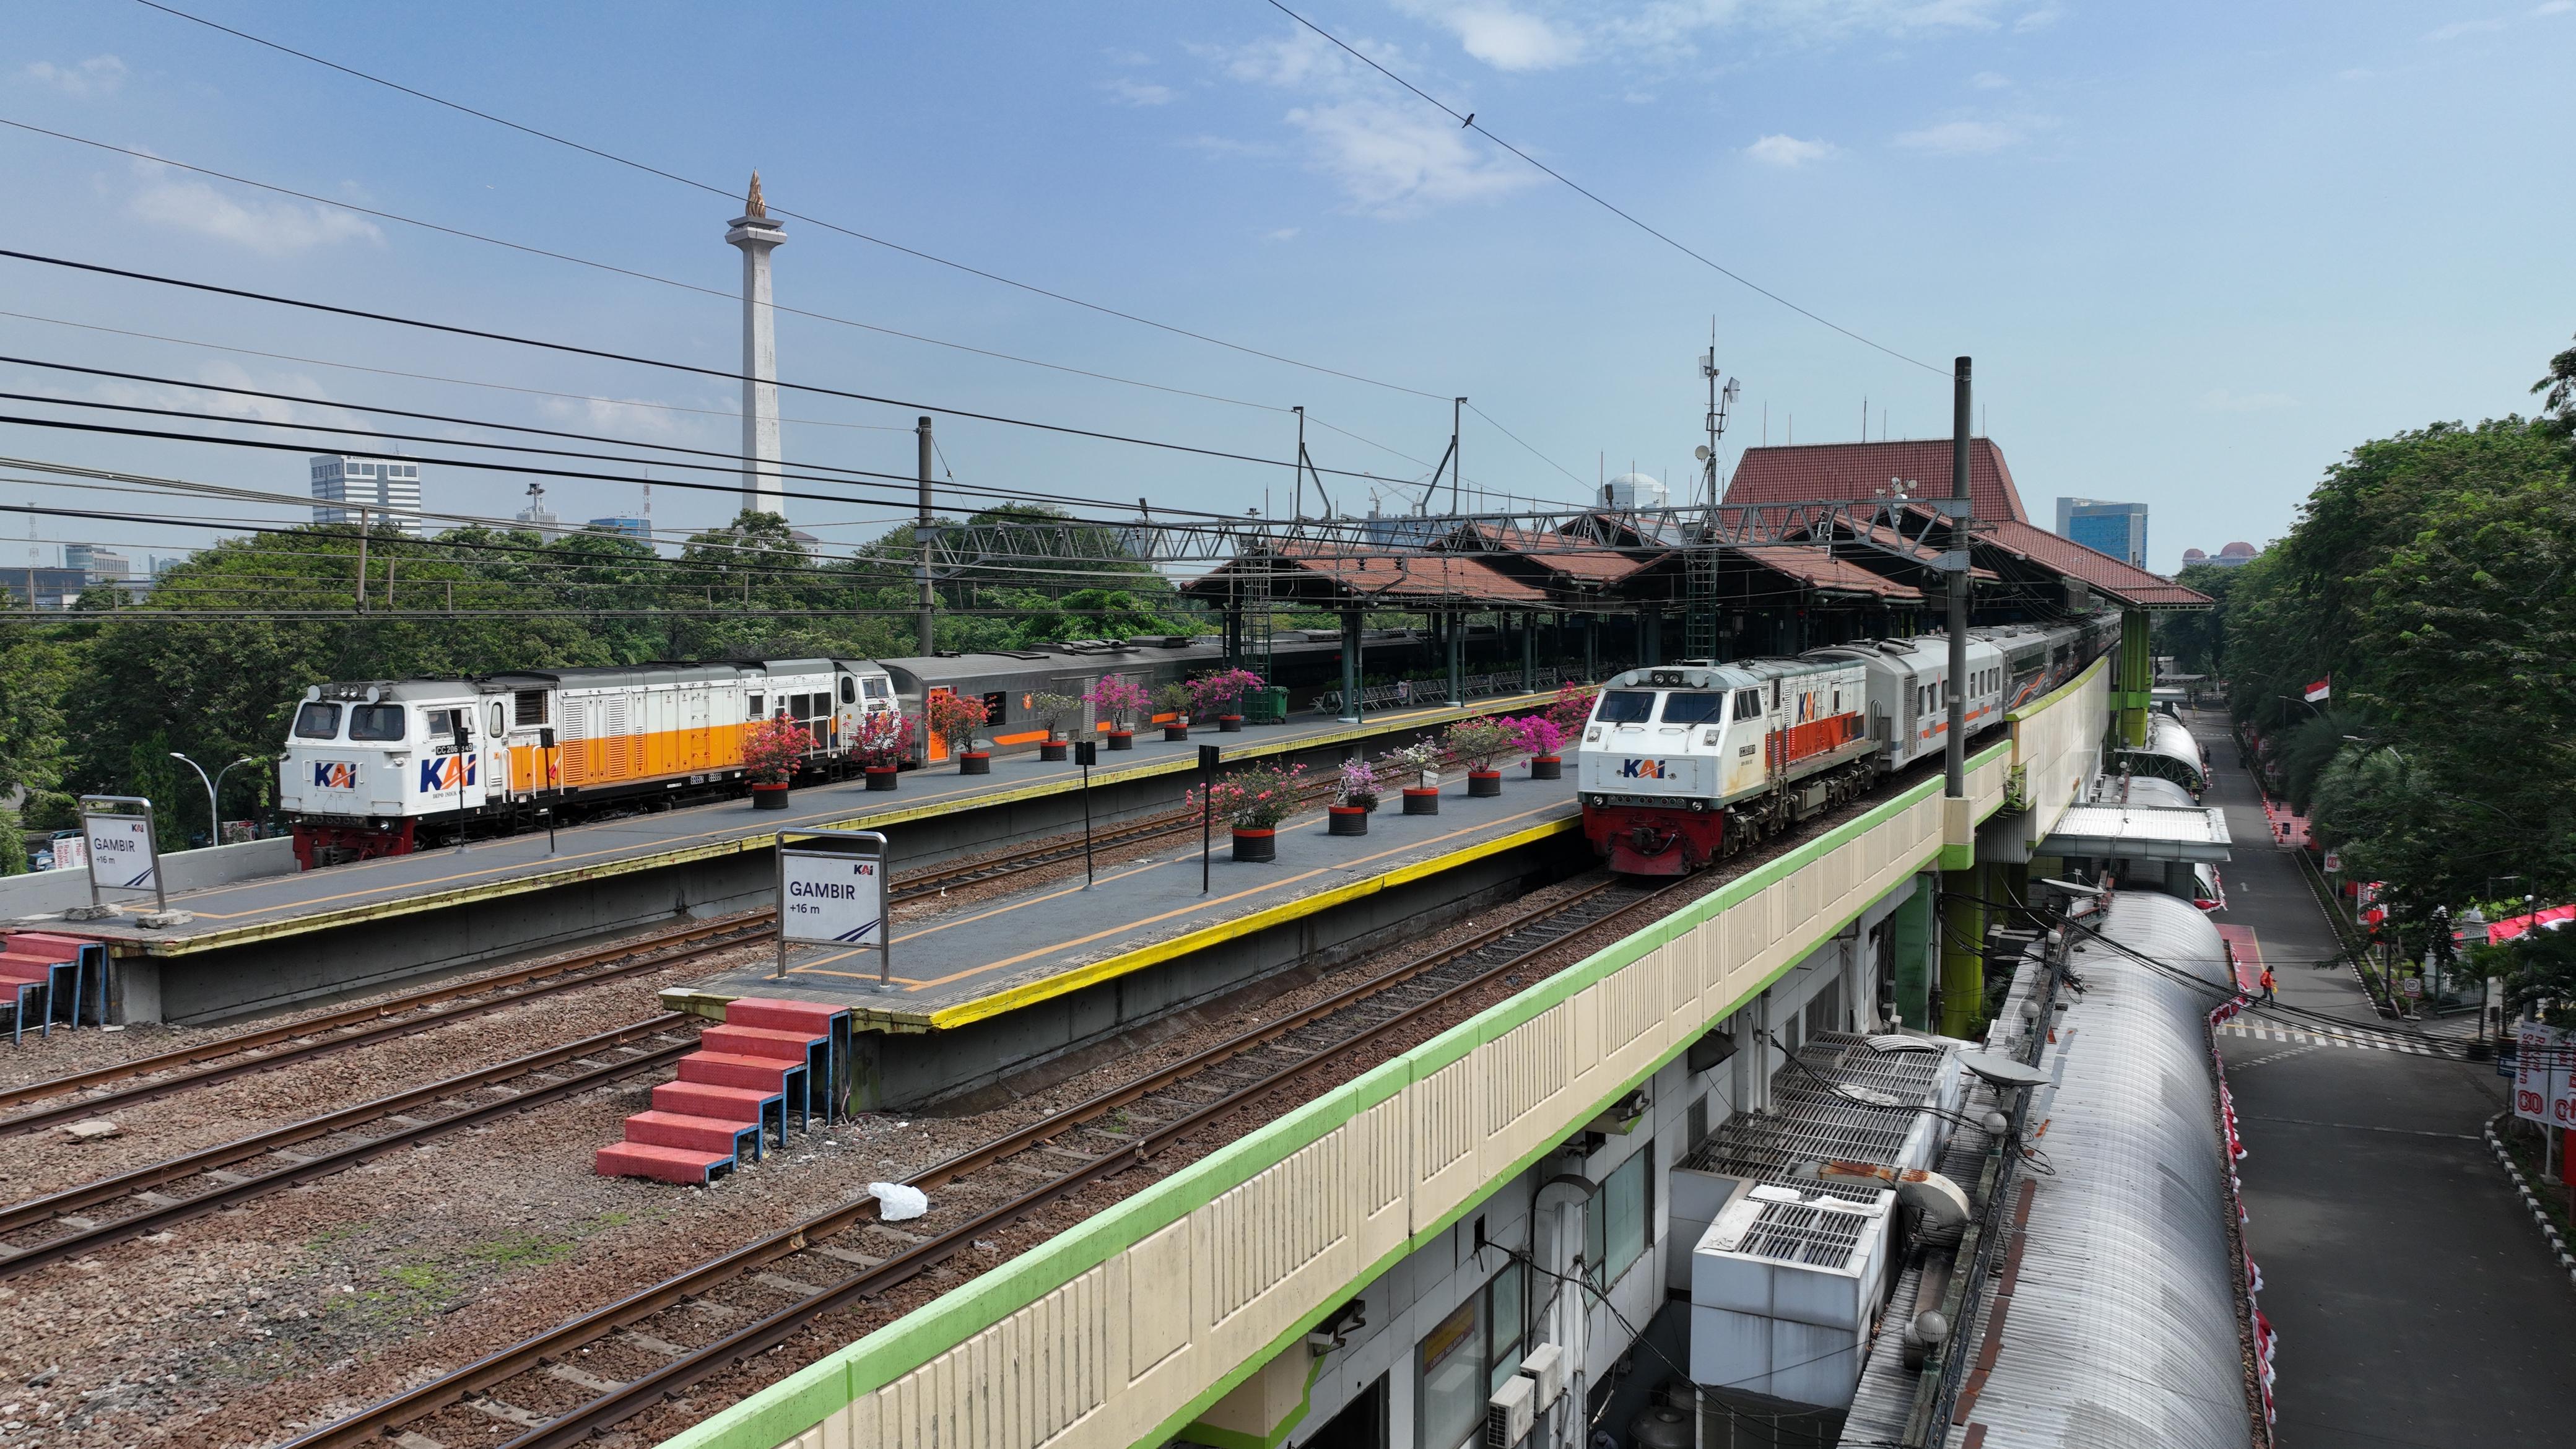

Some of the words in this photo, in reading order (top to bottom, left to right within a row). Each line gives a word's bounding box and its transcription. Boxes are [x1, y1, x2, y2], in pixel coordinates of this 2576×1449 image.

[1798, 691, 1816, 723] KAI
[437, 746, 446, 754] CC
[446, 746, 458, 754] 206
[315, 763, 357, 788] KAI
[420, 754, 476, 793] KAI
[1624, 759, 1665, 778] KAI
[132, 824, 144, 832] KAI
[94, 838, 135, 852] GAMBIR
[96, 855, 107, 864] +16
[854, 864, 873, 876] KAI
[790, 881, 855, 900] GAMBIR
[790, 903, 807, 913] +16
[810, 906, 820, 914] m
